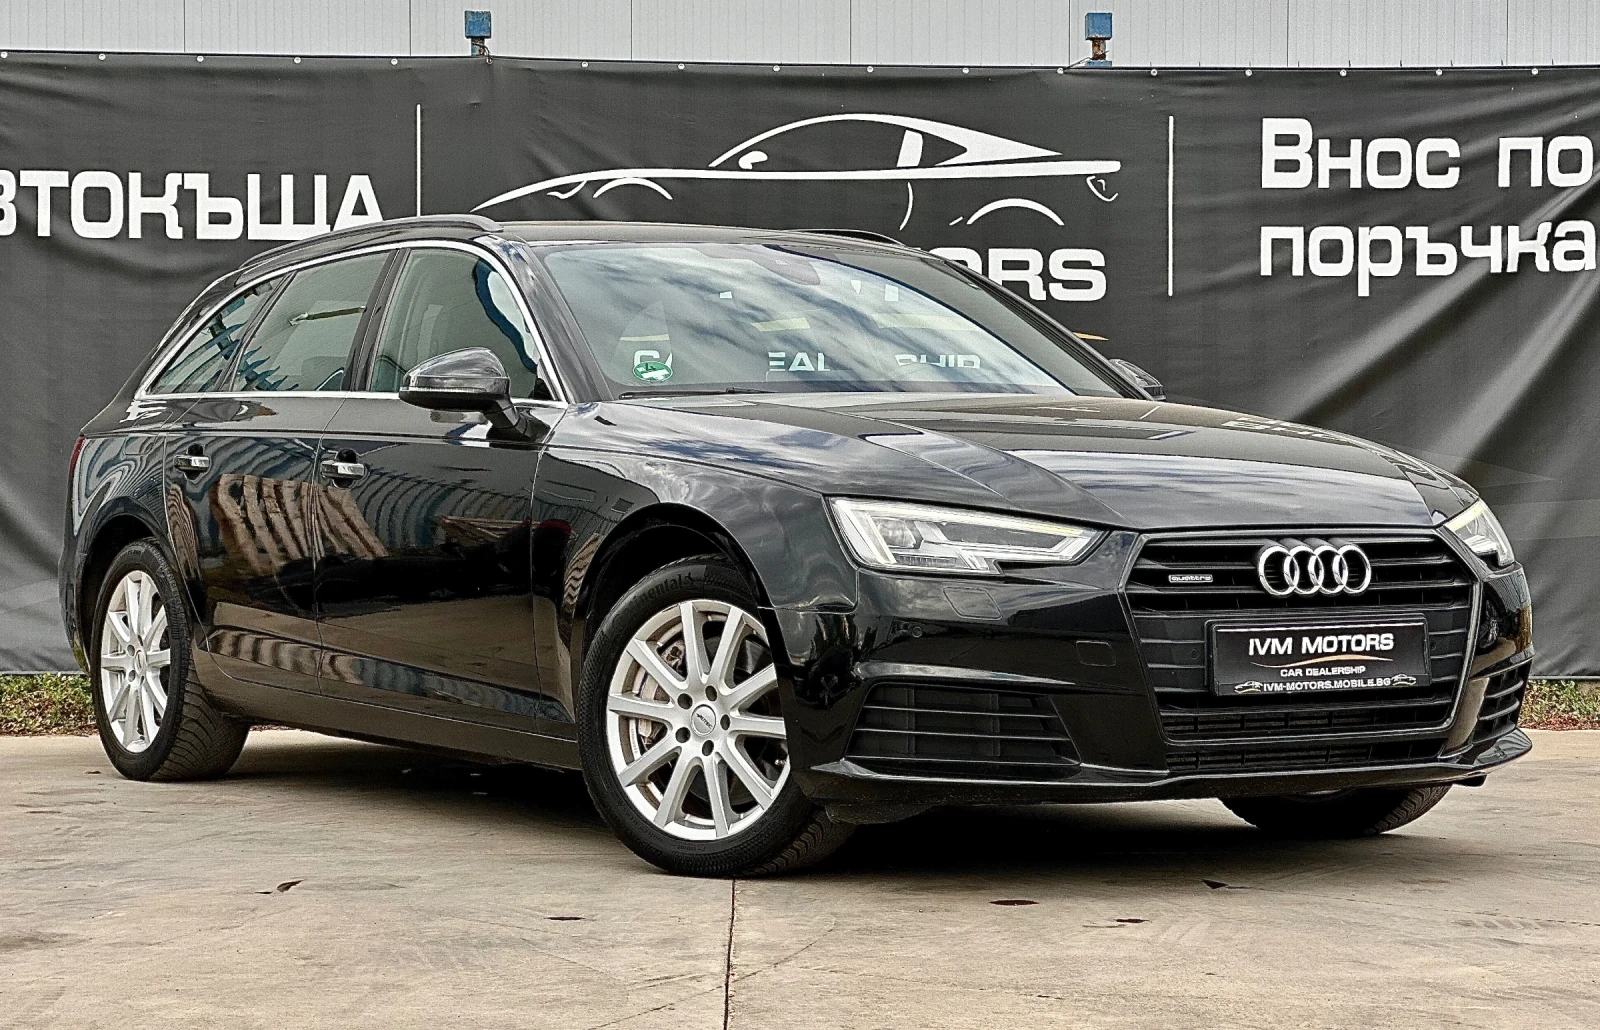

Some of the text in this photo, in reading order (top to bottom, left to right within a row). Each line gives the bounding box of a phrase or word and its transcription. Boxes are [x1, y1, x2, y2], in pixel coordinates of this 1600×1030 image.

[1261, 117, 1594, 189] Внос по
[1260, 219, 1597, 297] поръчка
[1170, 574, 1212, 582] quattro
[1248, 633, 1394, 656] IVM MOTORS
[1280, 665, 1366, 678] CAR DEALERSHIP
[1263, 677, 1391, 692] IVM-MOTORS.MOBILE.BG
